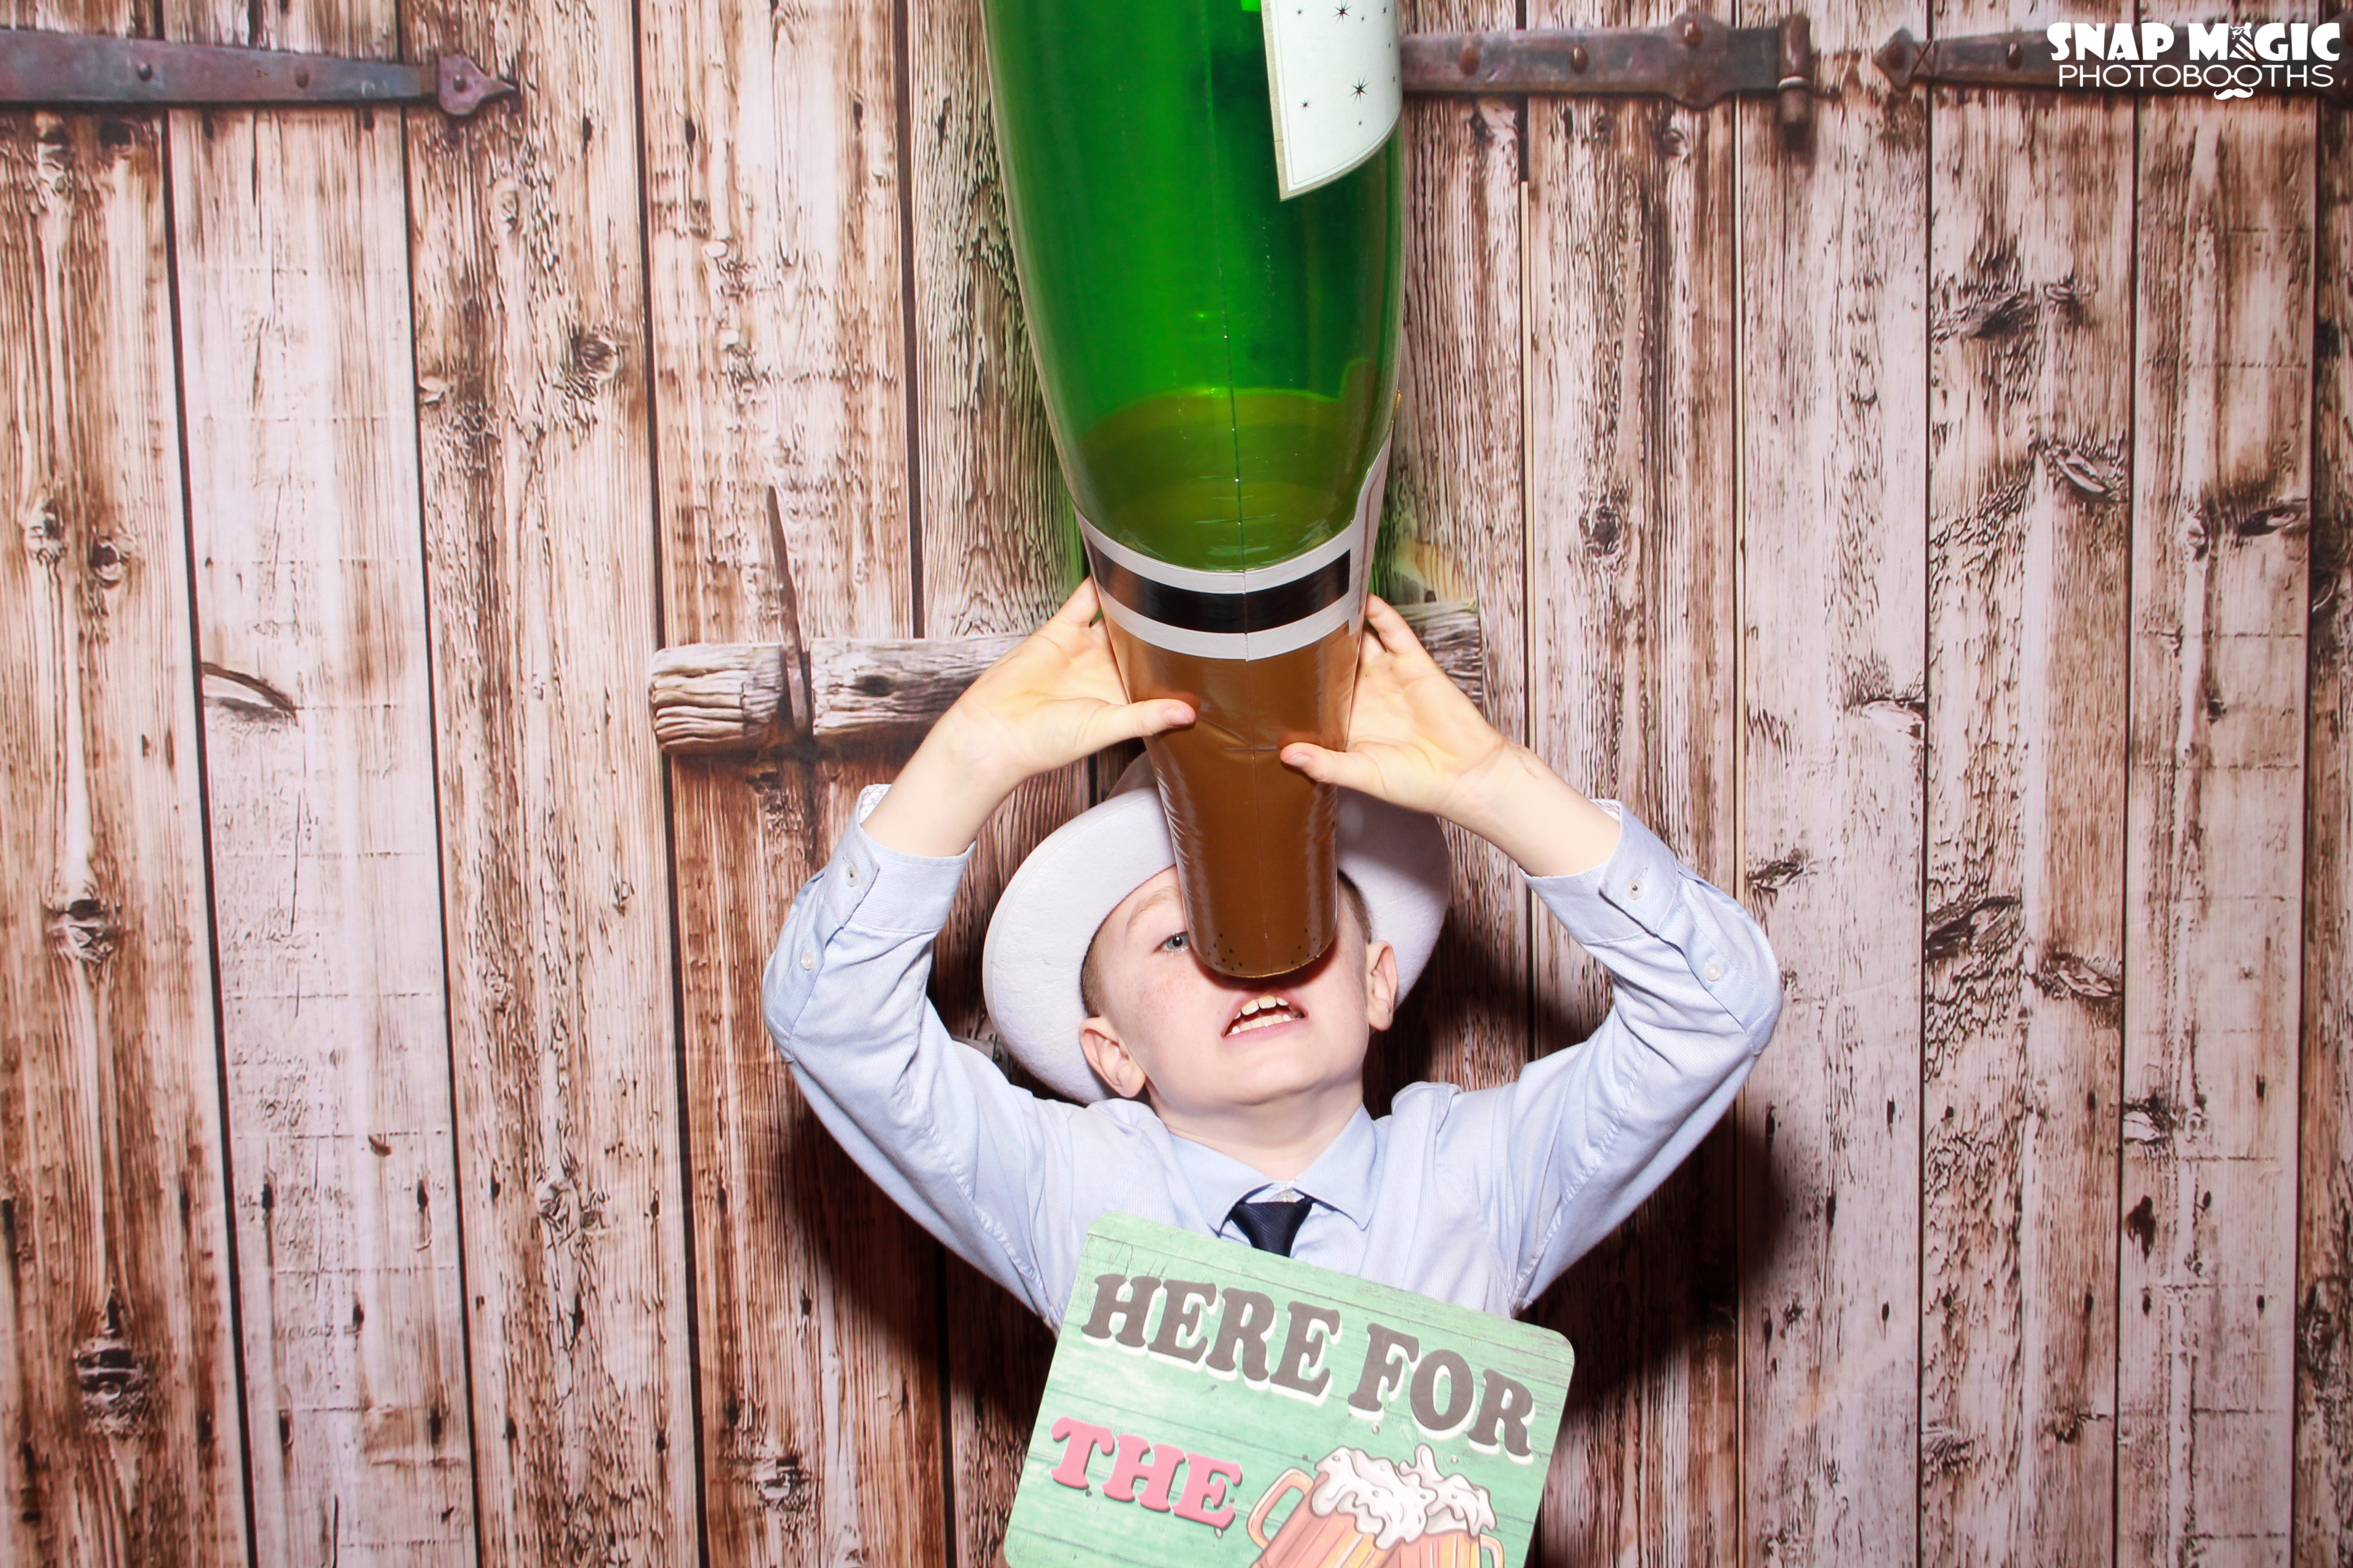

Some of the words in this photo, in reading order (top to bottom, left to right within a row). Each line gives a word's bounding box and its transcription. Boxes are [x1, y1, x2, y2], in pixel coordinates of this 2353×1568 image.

[1081, 1273, 1341, 1402] HERE
[1347, 1322, 1536, 1461] FOR
[1050, 1416, 1243, 1530] THE
